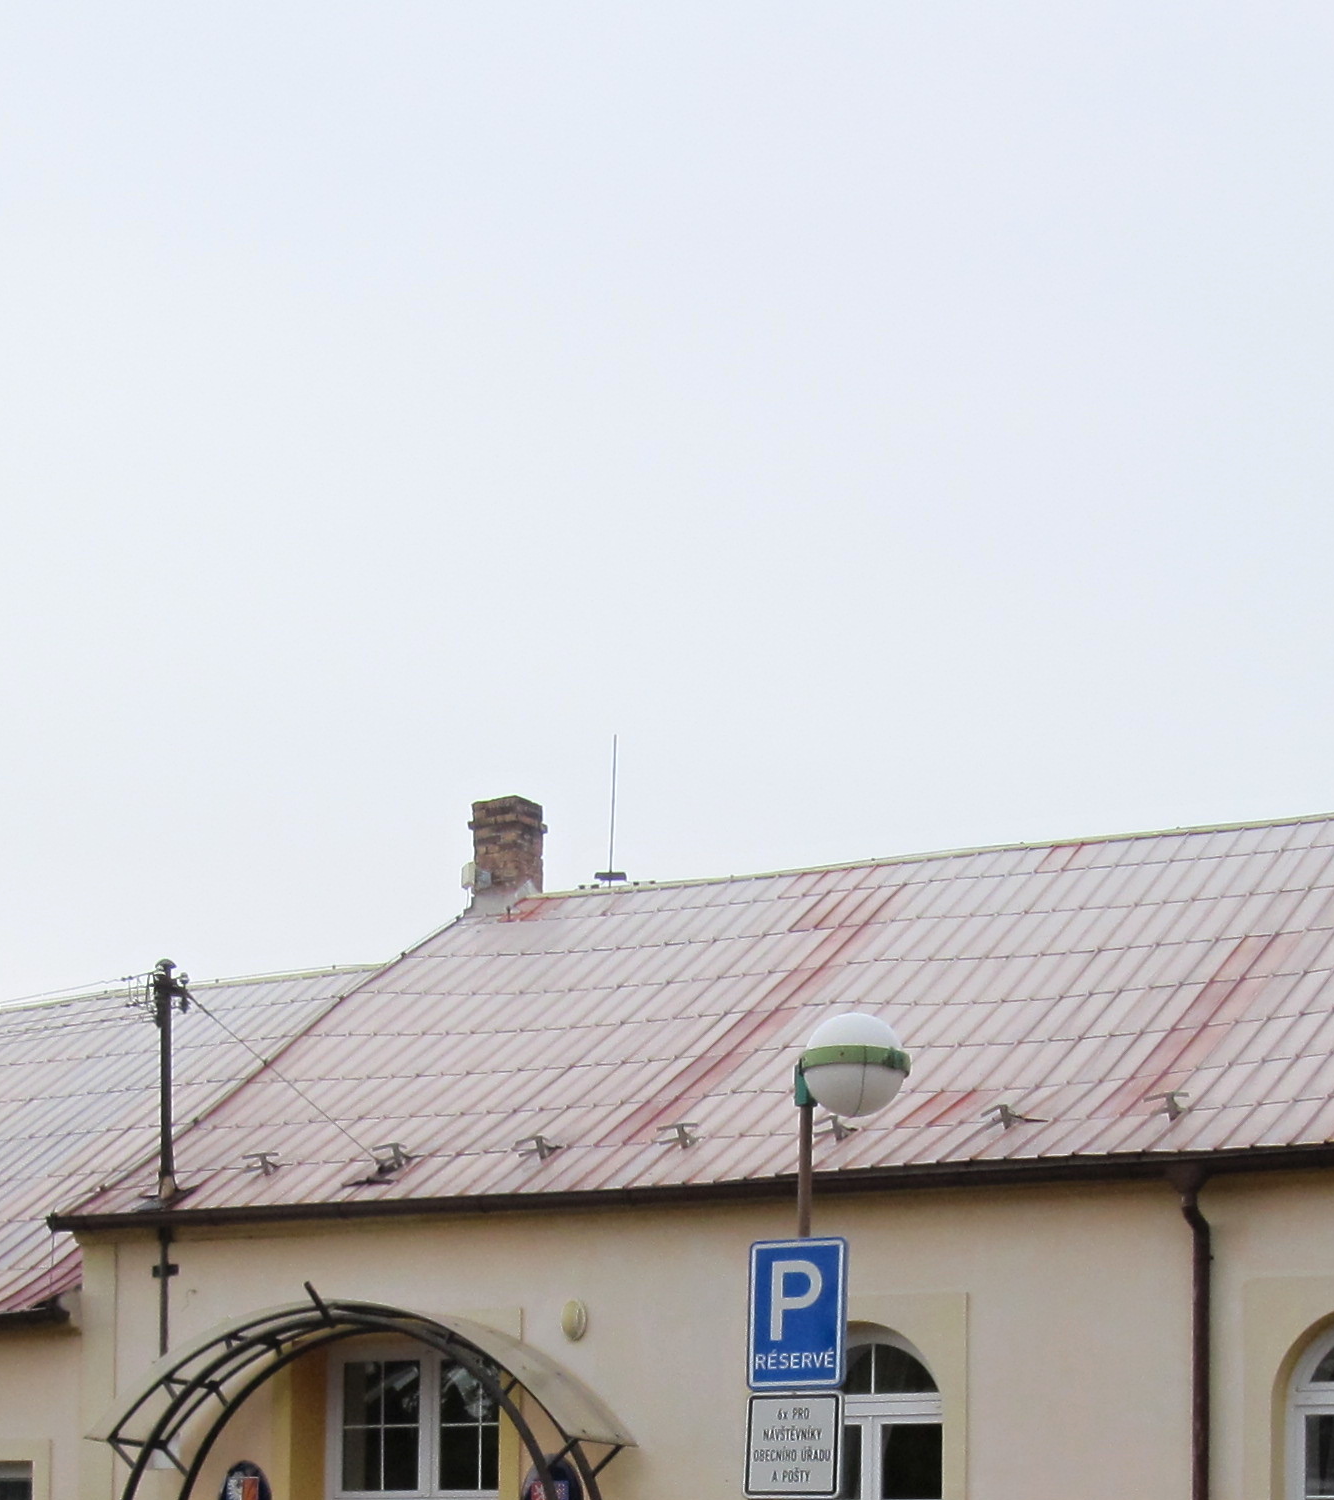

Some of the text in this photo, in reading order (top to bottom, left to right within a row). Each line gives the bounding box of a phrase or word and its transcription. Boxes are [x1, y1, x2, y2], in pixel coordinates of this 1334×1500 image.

[770, 1260, 823, 1341] P
[755, 1347, 835, 1370] RÉSERVÉ
[777, 1407, 810, 1420] 6x PRO
[763, 1425, 822, 1441] NÁVŠTĚVNÍKY
[753, 1446, 831, 1462] OBECNÍHO ÚŘADU
[772, 1467, 811, 1483] A POŠTY
